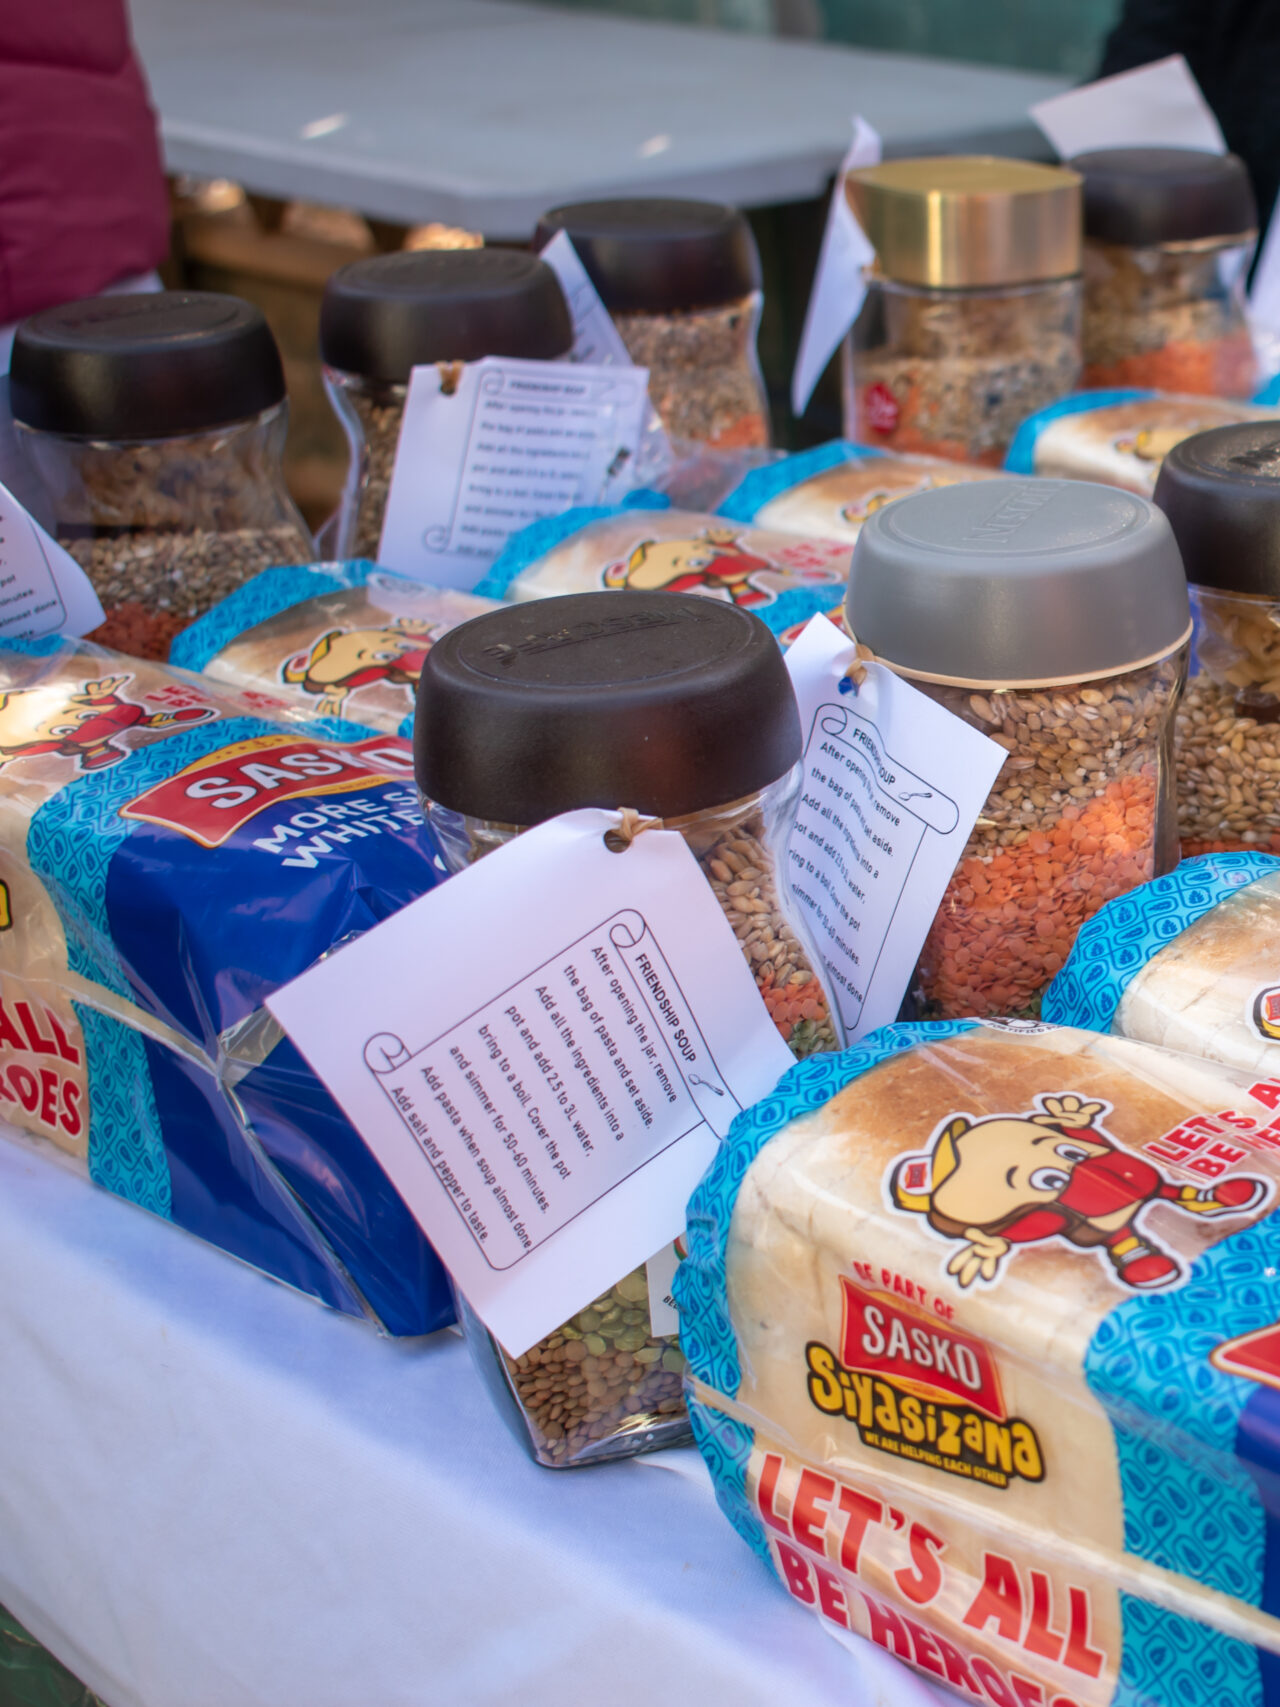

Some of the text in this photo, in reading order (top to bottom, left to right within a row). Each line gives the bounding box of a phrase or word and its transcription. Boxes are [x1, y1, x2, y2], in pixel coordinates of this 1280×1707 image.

[252, 798, 388, 854] MORE
[282, 810, 424, 869] WHITE
[805, 860, 814, 872] to
[535, 986, 624, 1141] Add all the ingredients into a
[563, 964, 653, 1130] the bag of pasta and set aside.
[591, 946, 676, 1102] After opening the jar, remove
[635, 953, 696, 1061] FRIENDSHIP SOUP
[421, 1066, 443, 1091] Add
[434, 1091, 461, 1125] pasta
[458, 1126, 480, 1157] when
[476, 1157, 496, 1185] soup
[492, 1186, 518, 1222] almost
[449, 1046, 549, 1214] and simmer for 50-60 minutes.
[478, 1024, 502, 1059] bring
[498, 1057, 510, 1072] to
[506, 1073, 516, 1082] a
[527, 1107, 549, 1139] Cover
[545, 1140, 559, 1159] the
[552, 1160, 571, 1179] pot
[504, 1005, 593, 1156] pot and add 2.5 to 3L water,
[391, 1087, 488, 1243] Add salt and pepper to taste.
[1196, 1140, 1248, 1179] BE
[853, 1261, 955, 1322] BE PART OF
[861, 1304, 983, 1392] SASKO
[900, 1441, 942, 1466] HELPING
[943, 1456, 972, 1477] EACH
[973, 1464, 1007, 1487] OTHER
[758, 1453, 1105, 1679] LET'S ALL
[774, 1536, 849, 1627] BE
